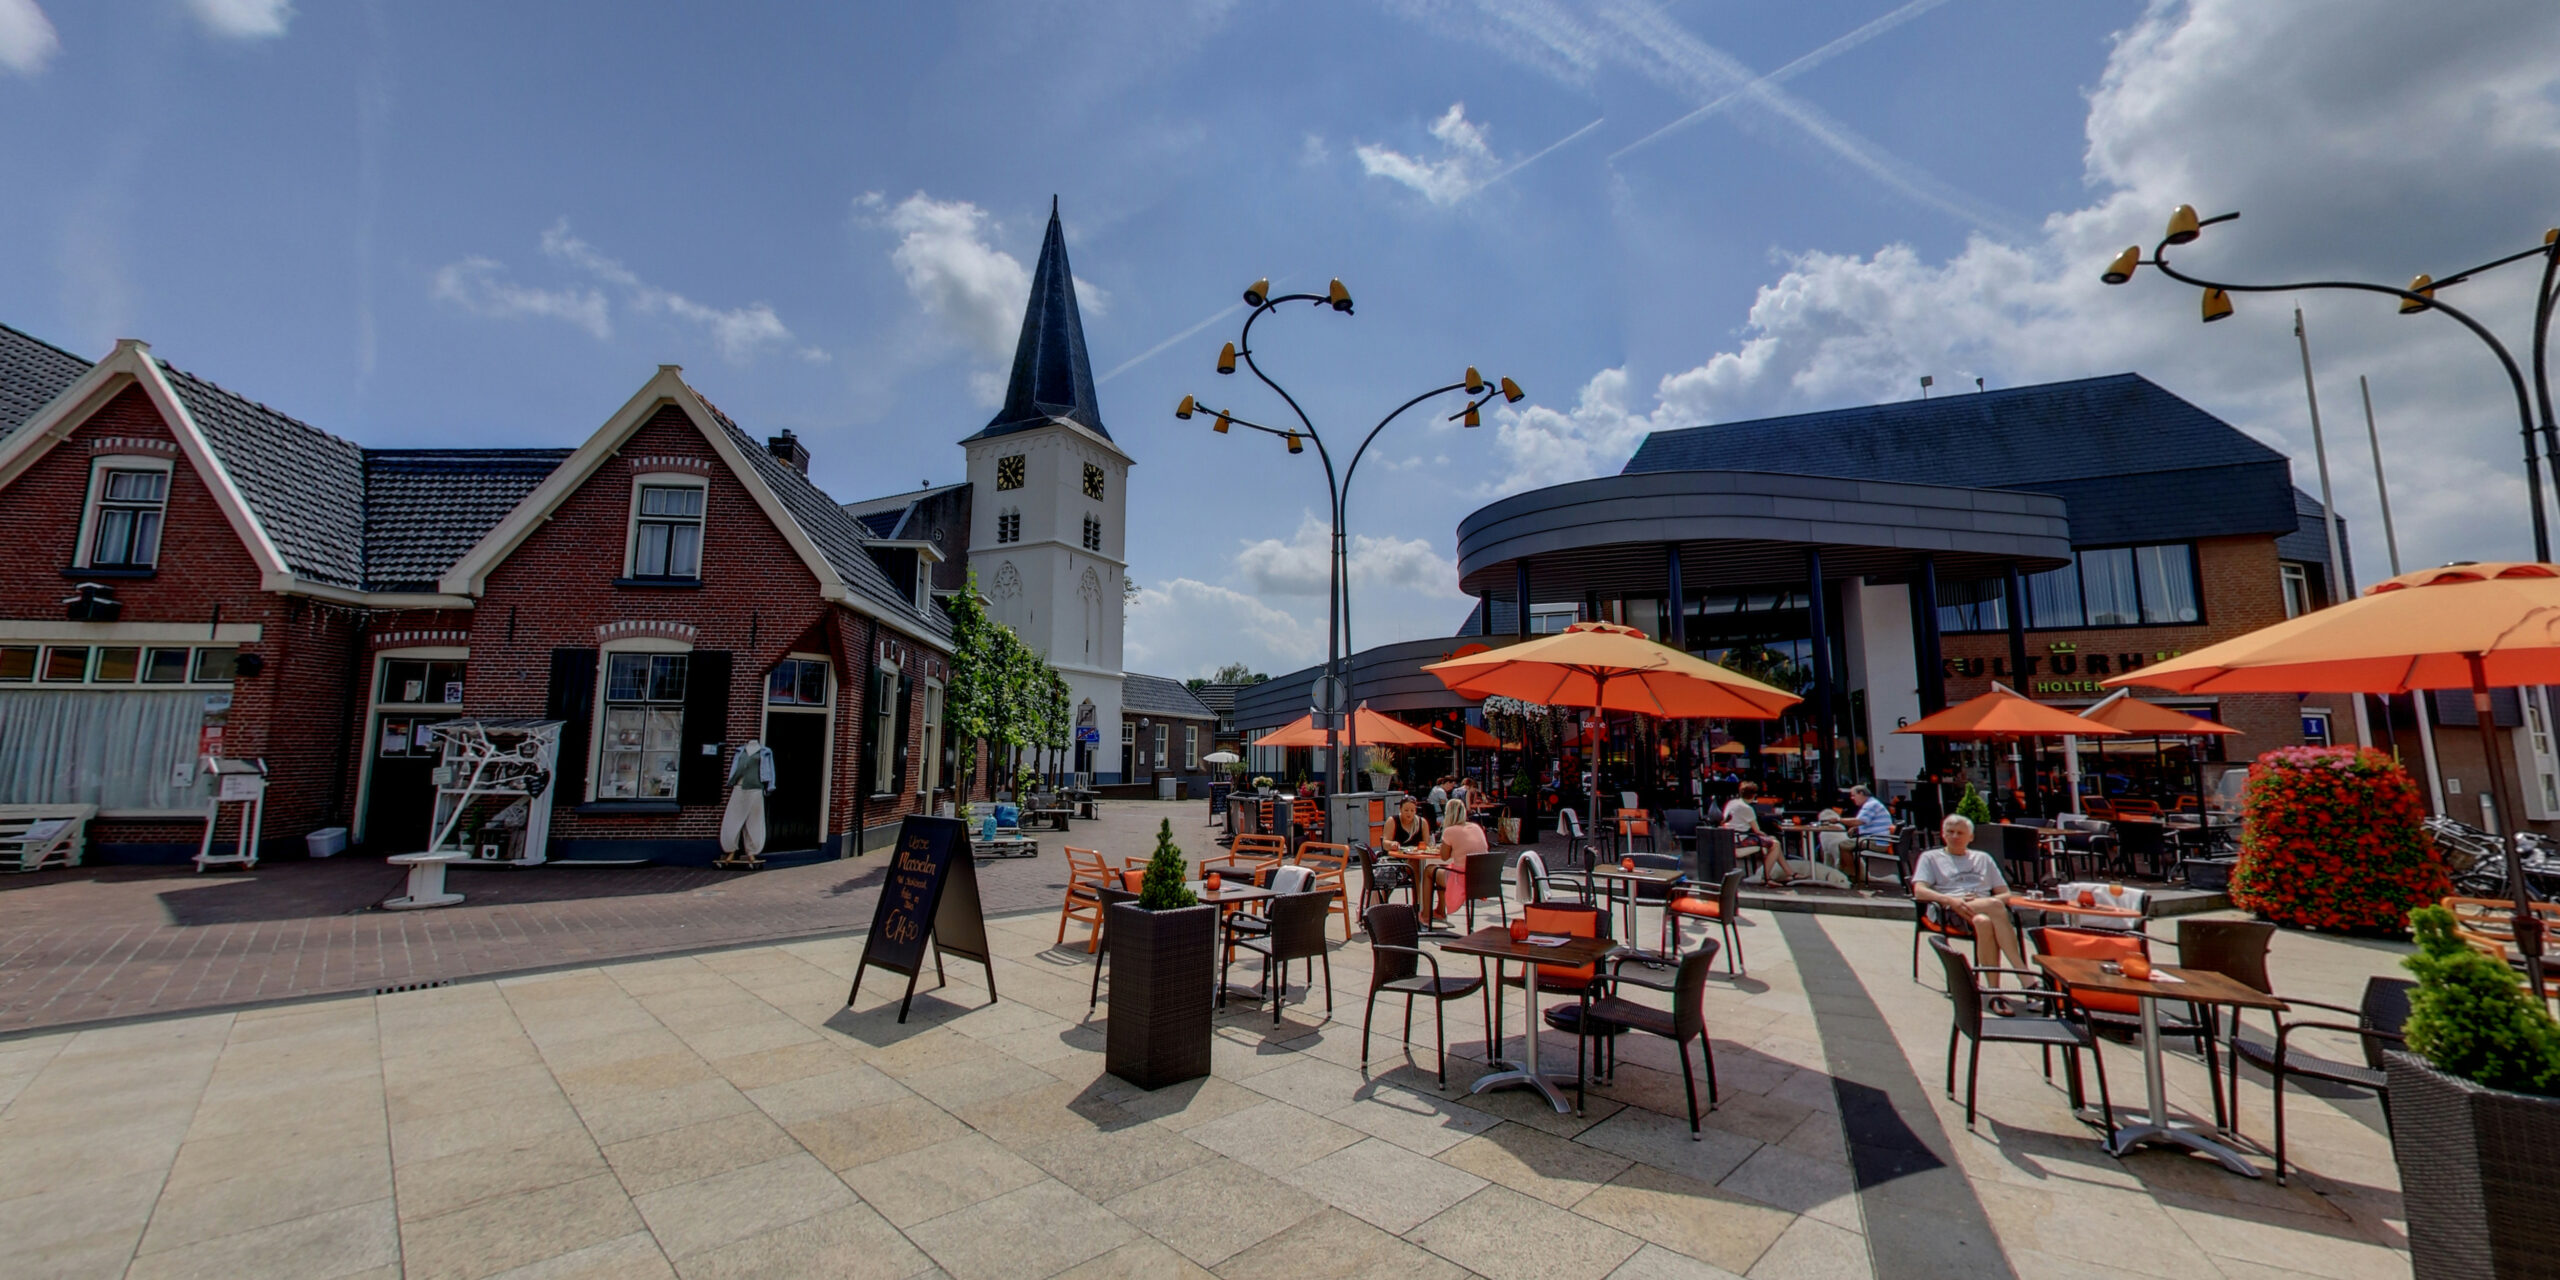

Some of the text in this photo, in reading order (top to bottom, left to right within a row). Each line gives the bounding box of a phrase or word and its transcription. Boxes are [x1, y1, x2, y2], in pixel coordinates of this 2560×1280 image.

[2038, 681, 2106, 693] HOLTEN
[1895, 716, 1908, 729] 6
[898, 852, 936, 875] Mosselen
